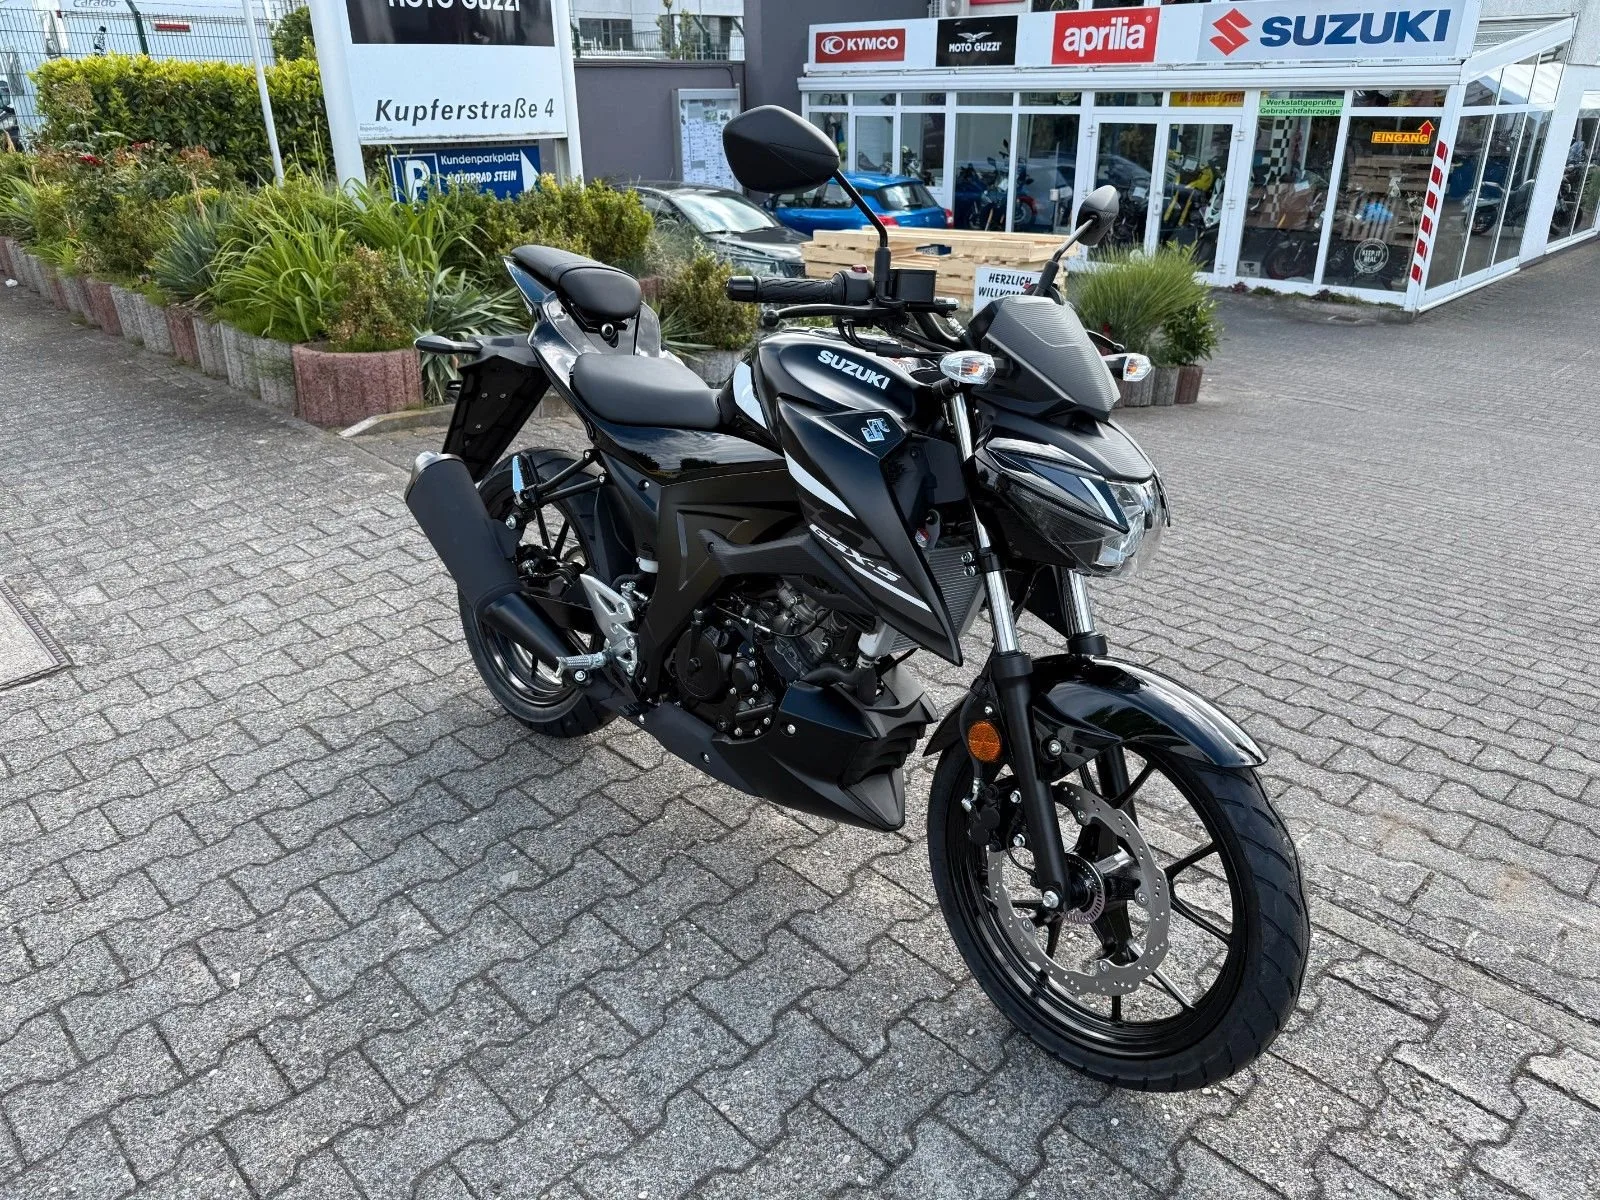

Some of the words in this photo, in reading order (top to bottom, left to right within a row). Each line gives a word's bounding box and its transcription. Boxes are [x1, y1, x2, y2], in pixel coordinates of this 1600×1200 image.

[1260, 9, 1451, 47] SUZUKI
[847, 36, 898, 51] KYMCO
[1063, 17, 1146, 57] aprilia
[949, 42, 971, 53] MOTO
[974, 41, 1001, 52] GUZZI
[375, 97, 538, 127] Kupferstraße
[544, 98, 555, 118] 4
[1260, 107, 1341, 116] Gebrauchtfahrzeuge
[1374, 133, 1429, 143] EINGANG
[440, 152, 520, 165] Kundenparkplatz
[494, 170, 517, 183] STEIN
[988, 273, 1032, 286] HERZLICH
[817, 350, 891, 390] SUZUKI
[809, 523, 901, 582] GSX-S
